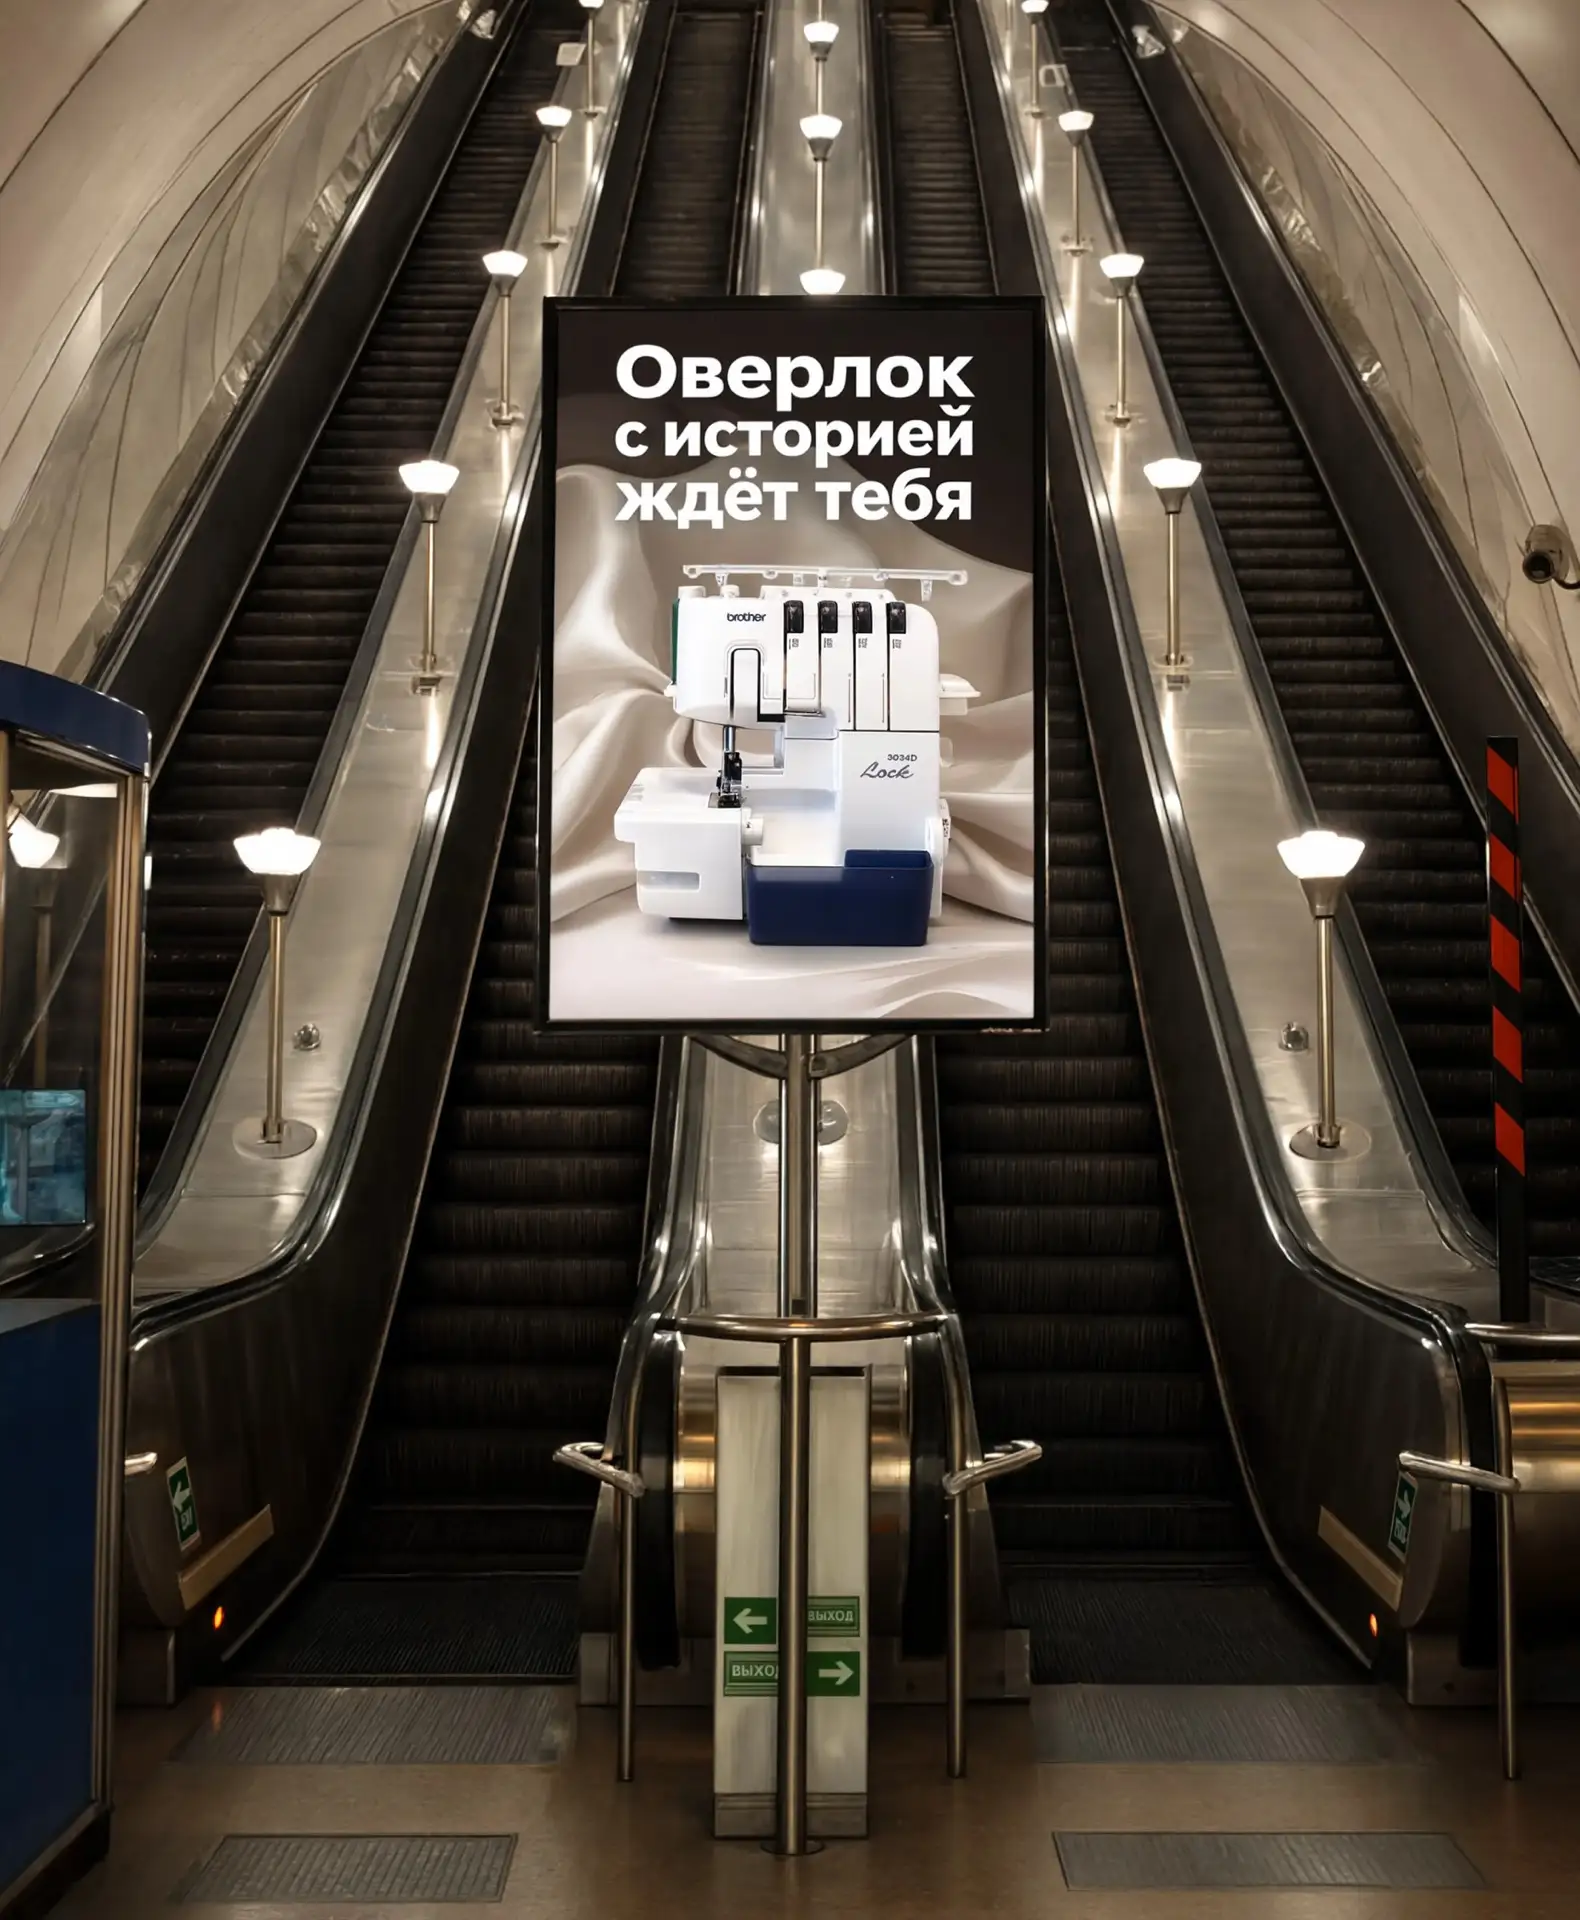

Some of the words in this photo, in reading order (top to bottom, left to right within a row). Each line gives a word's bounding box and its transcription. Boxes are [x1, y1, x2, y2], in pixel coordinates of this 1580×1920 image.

[616, 344, 974, 411] Оверлок
[615, 421, 648, 457] с
[664, 404, 973, 468] историей
[614, 467, 798, 529] ждёт
[815, 467, 972, 521] тебя
[726, 612, 767, 622] brother
[887, 753, 918, 762] 3034D
[860, 761, 915, 779] Lock
[807, 1610, 854, 1622] ВЫХОД
